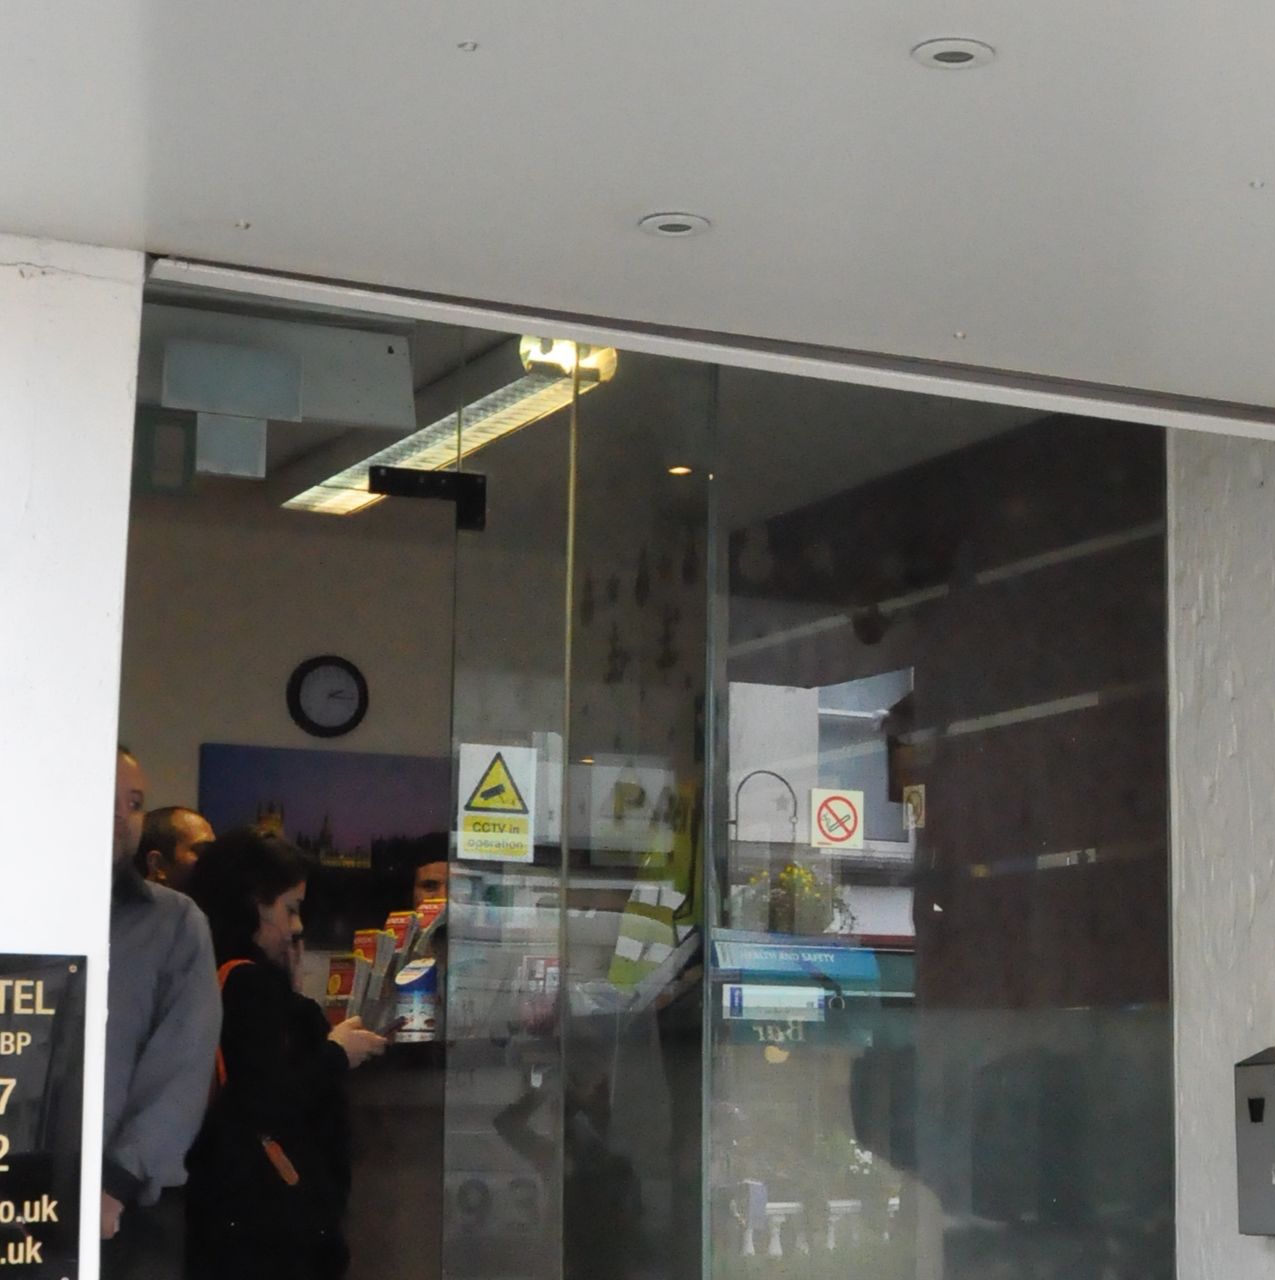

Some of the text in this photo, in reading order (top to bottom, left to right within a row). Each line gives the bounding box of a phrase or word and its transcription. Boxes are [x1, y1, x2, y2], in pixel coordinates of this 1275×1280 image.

[471, 821, 520, 834] CCTV in
[467, 839, 523, 850] operation
[0, 980, 55, 1015] TEL
[0, 1031, 32, 1055] BP
